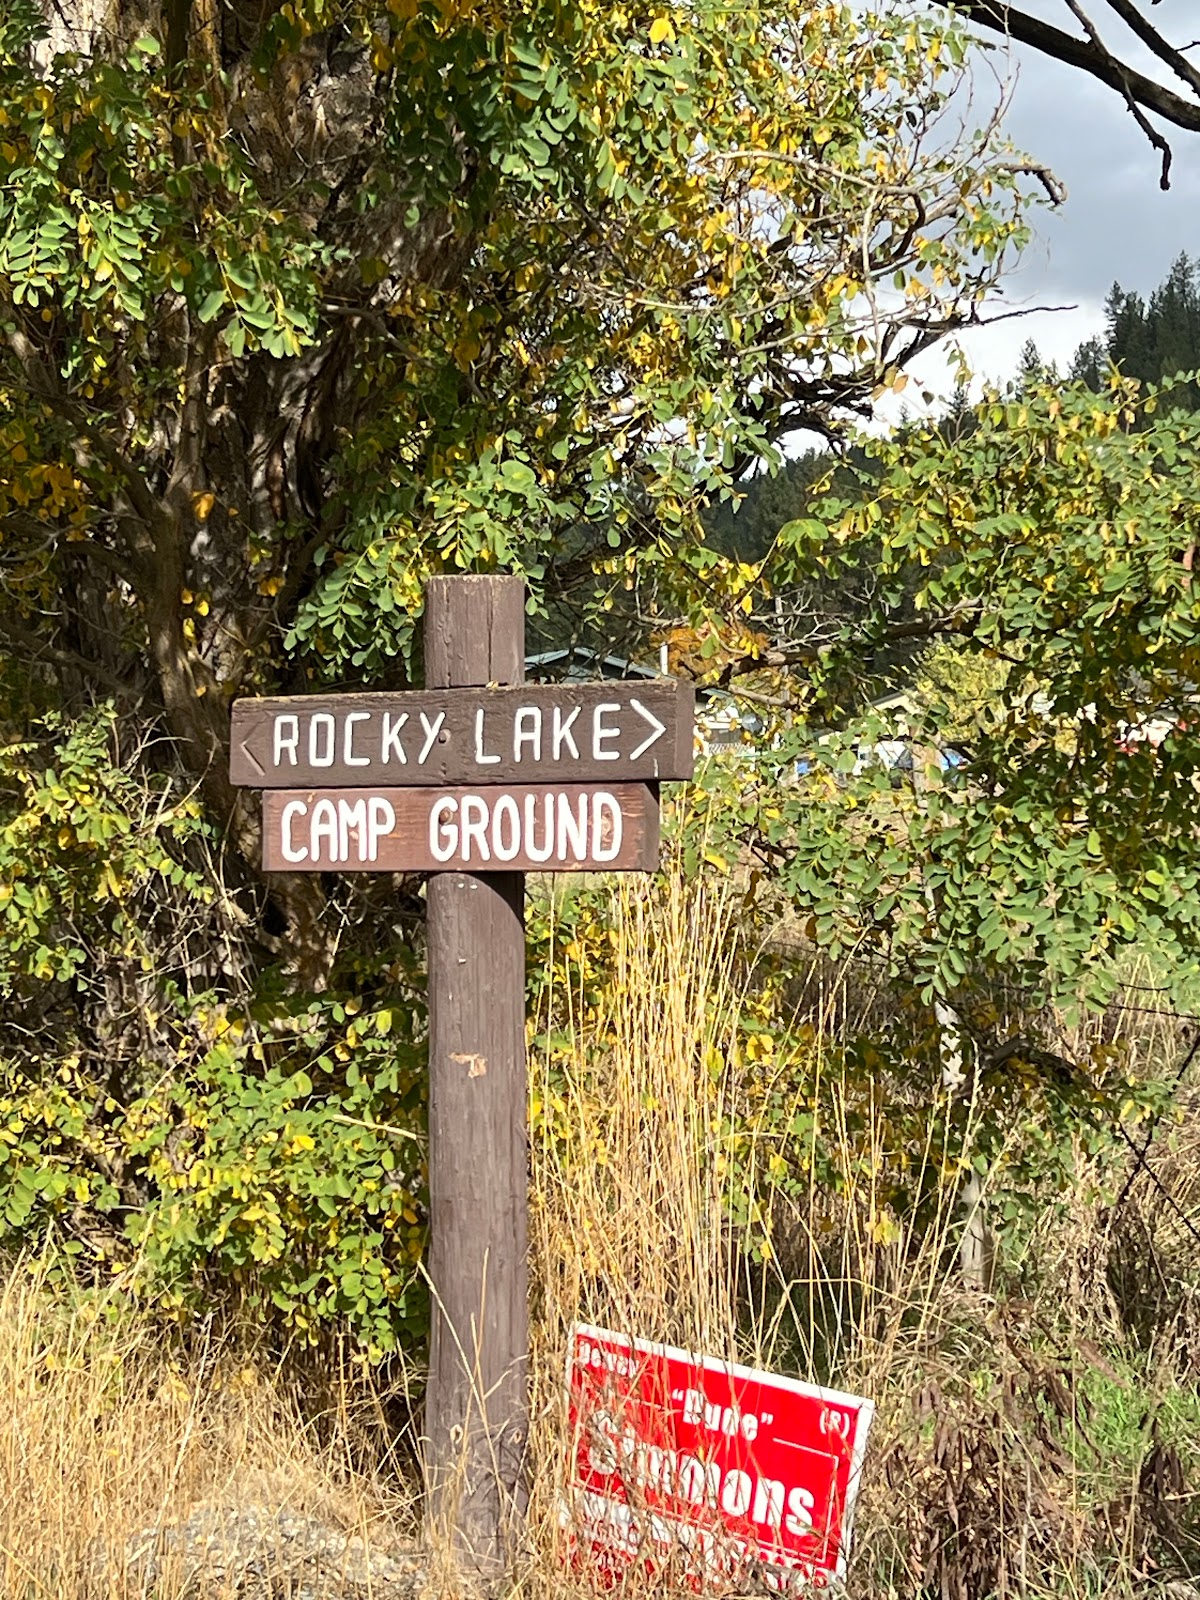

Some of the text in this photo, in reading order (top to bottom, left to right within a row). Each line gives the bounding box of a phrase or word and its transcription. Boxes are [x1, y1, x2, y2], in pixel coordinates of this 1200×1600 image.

[272, 702, 622, 767] ROCKY LAKE
[281, 791, 623, 863] CAMP GROUND
